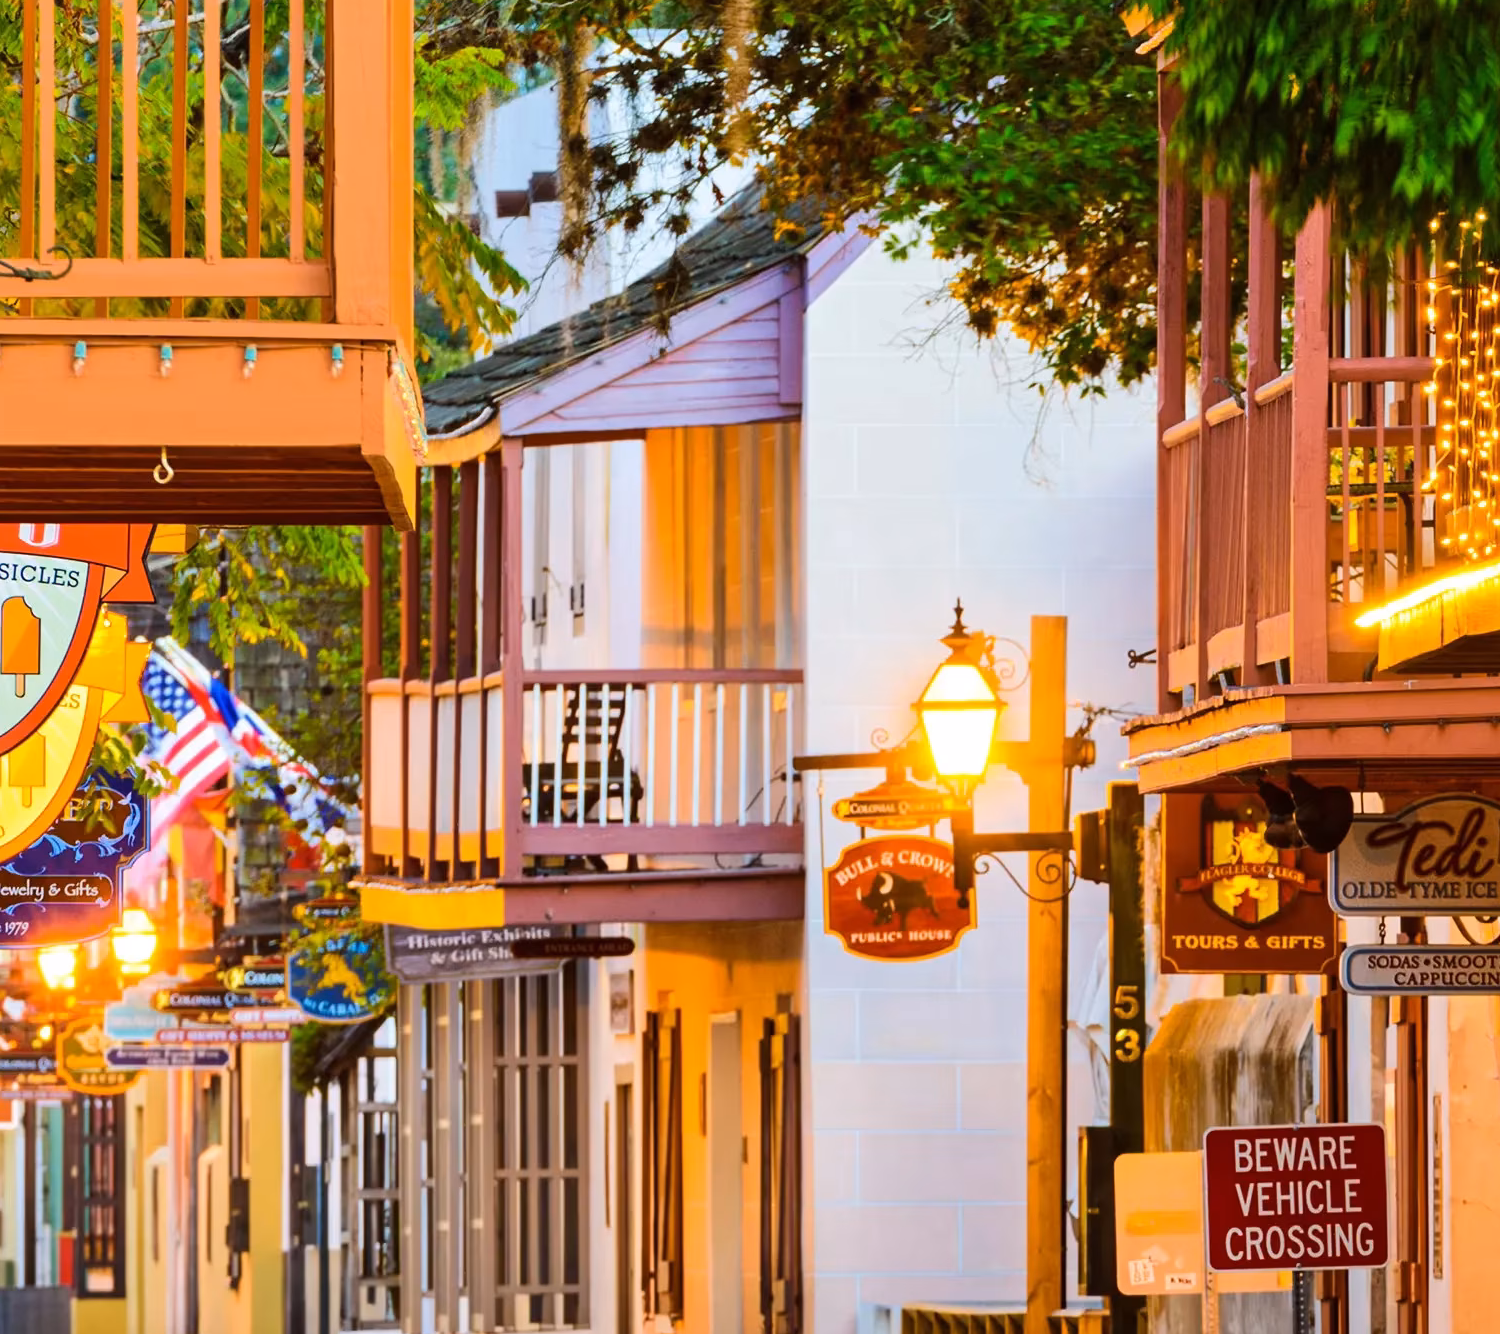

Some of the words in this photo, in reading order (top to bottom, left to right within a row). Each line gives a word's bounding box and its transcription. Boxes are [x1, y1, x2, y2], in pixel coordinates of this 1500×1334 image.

[835, 855, 879, 887] BULL
[880, 851, 894, 867] &
[1200, 864, 1250, 883] FLAGLER
[1252, 865, 1306, 884] COLLEGE
[49, 883, 61, 897] &
[64, 878, 100, 897] Gifts
[1342, 881, 1397, 899] OLDE
[1407, 881, 1461, 899] TYME
[1466, 882, 1498, 899] ICE
[4, 921, 30, 936] 1979
[908, 929, 953, 942] HOUSE
[407, 928, 476, 949] Historic
[1172, 935, 1239, 950] TOURS
[1244, 935, 1260, 950] &
[1266, 935, 1326, 950] GIFTS
[430, 952, 447, 965] &
[450, 947, 484, 963] Gift
[487, 945, 513, 960] Sh
[1368, 955, 1421, 969] SODAS
[243, 970, 285, 986] COLON
[1234, 1135, 1357, 1173] BEWARE
[1235, 1178, 1362, 1217] VEHICLE
[1225, 1222, 1374, 1261] CROSSING
